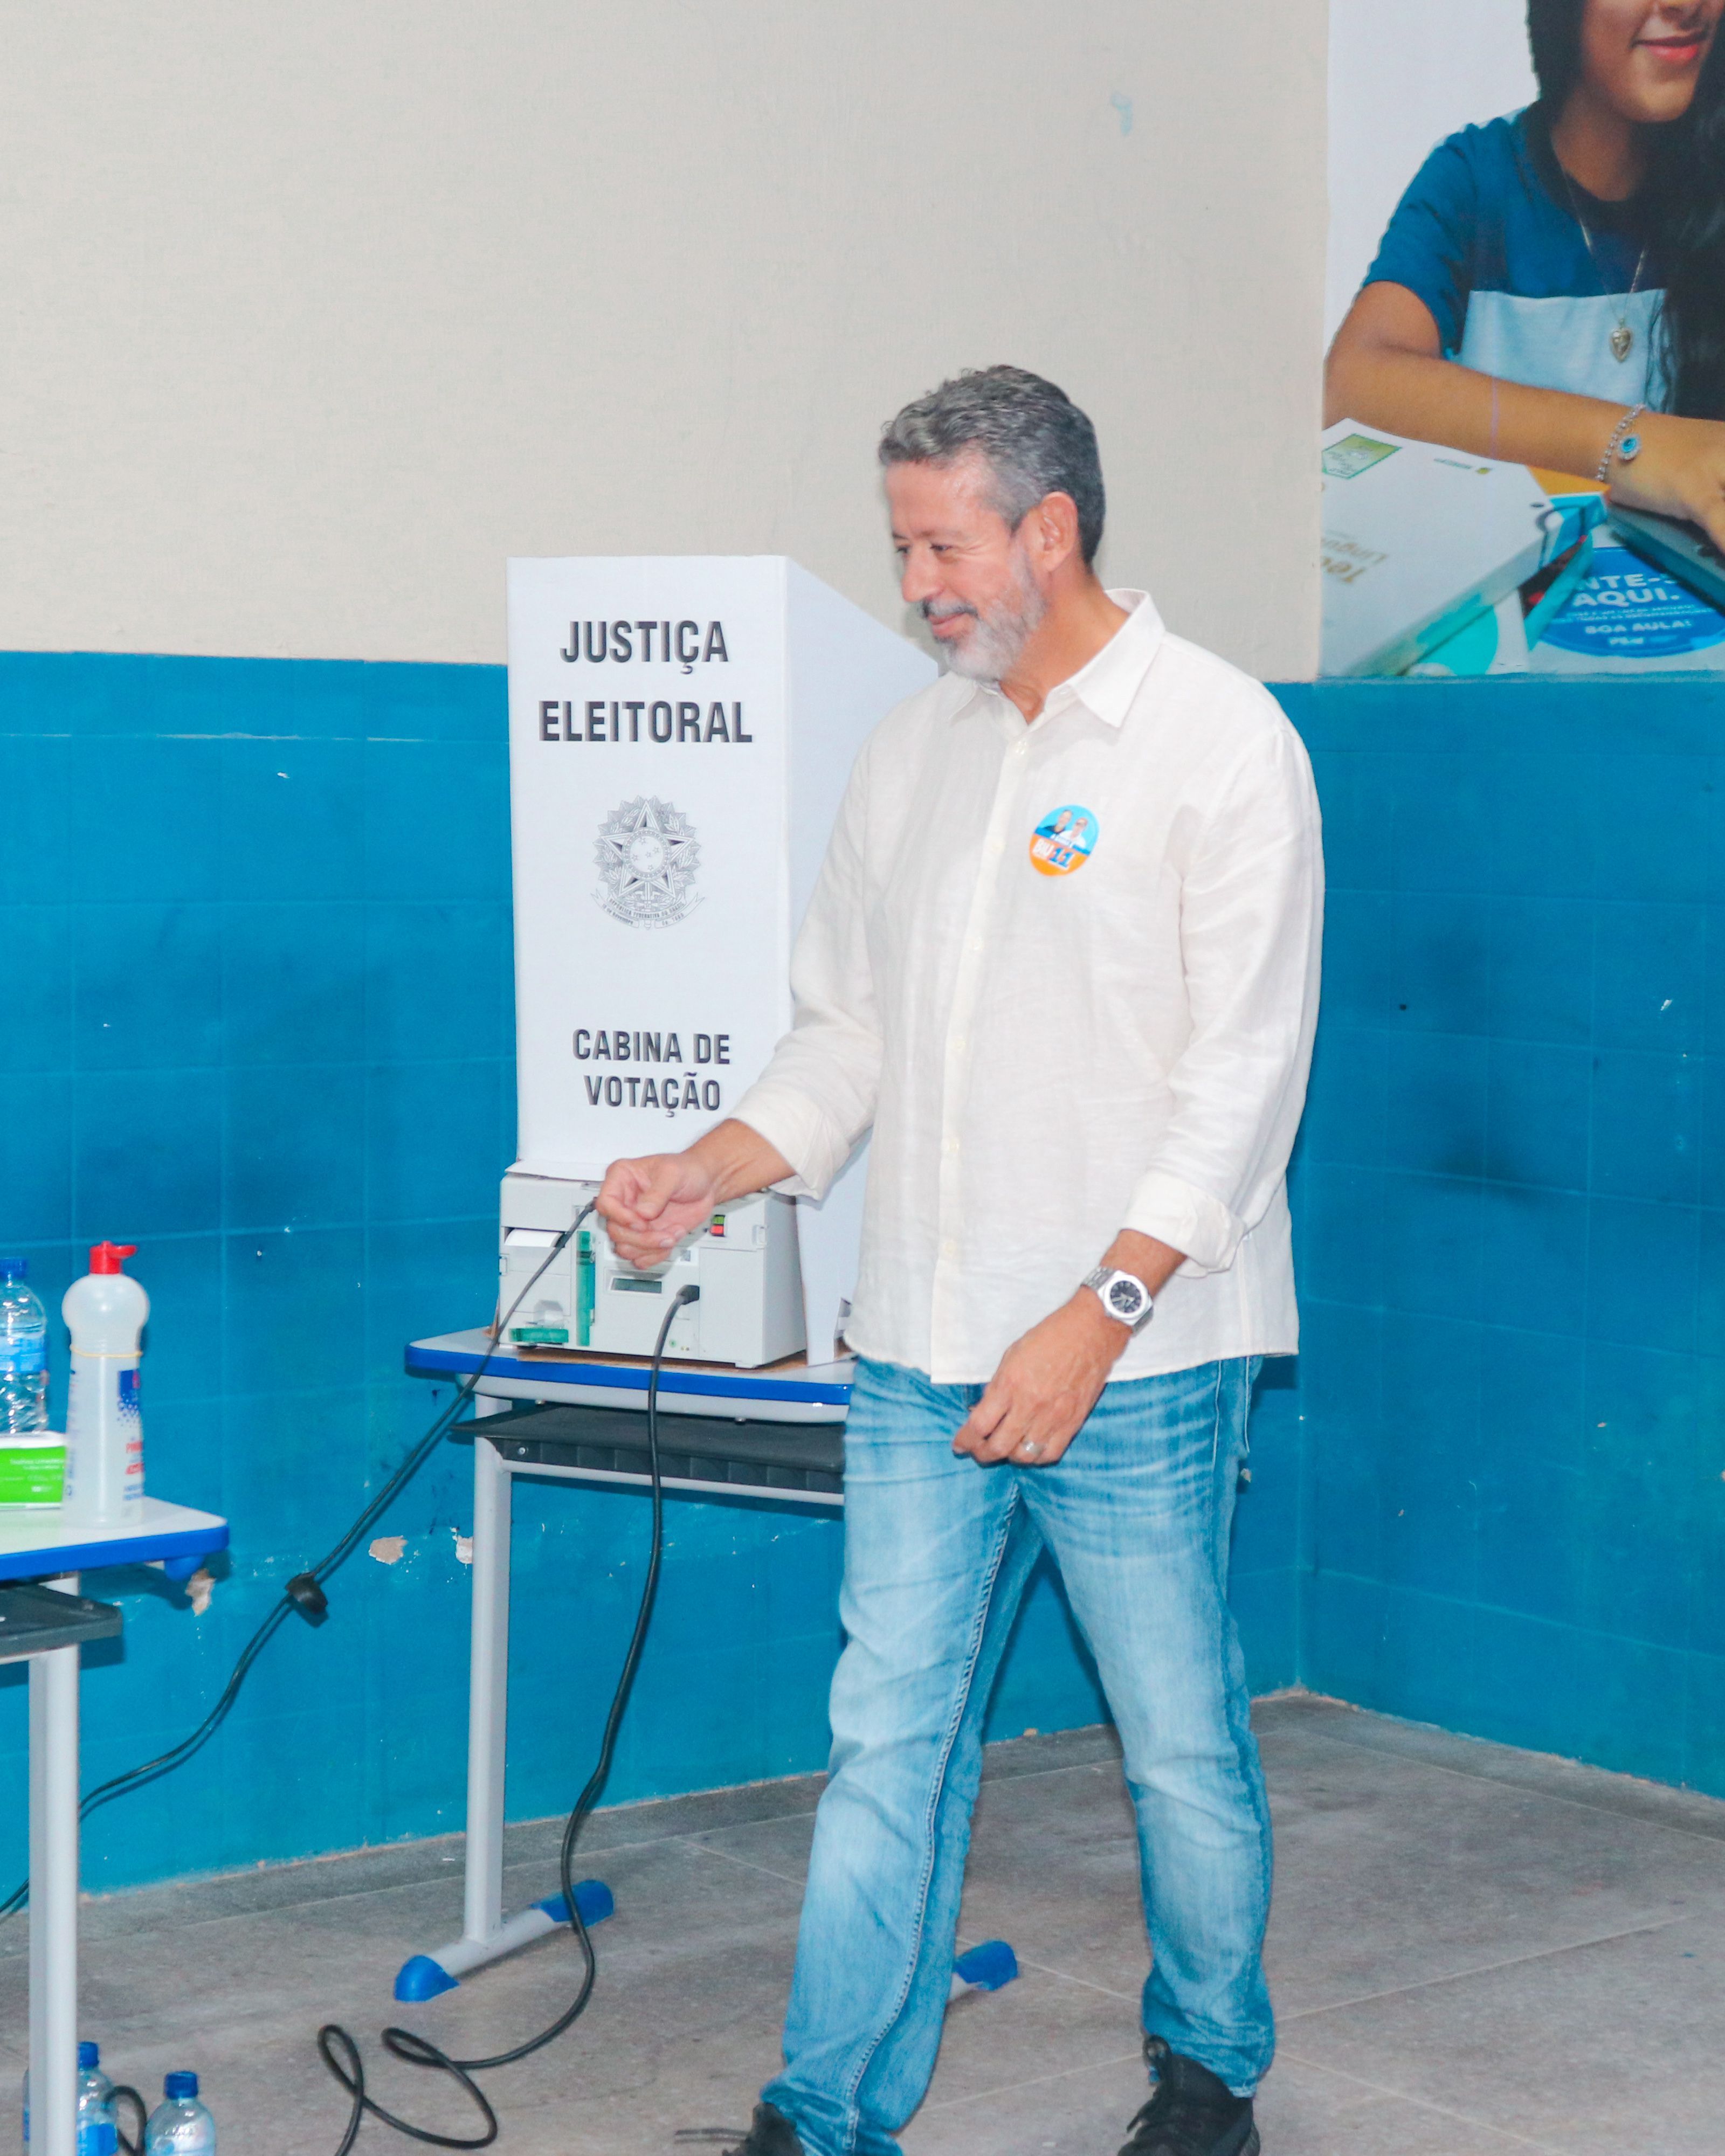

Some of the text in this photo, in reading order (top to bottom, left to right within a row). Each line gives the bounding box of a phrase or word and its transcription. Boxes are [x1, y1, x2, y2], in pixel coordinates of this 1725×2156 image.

[1572, 587, 1680, 607] AQUI.
[560, 620, 728, 674] JUSTIÇA
[1584, 625, 1627, 634] BOA
[539, 701, 753, 743] ELEITORAL
[573, 1028, 730, 1065] CABINA DE
[584, 1072, 720, 1118] VOTAÇÃO
